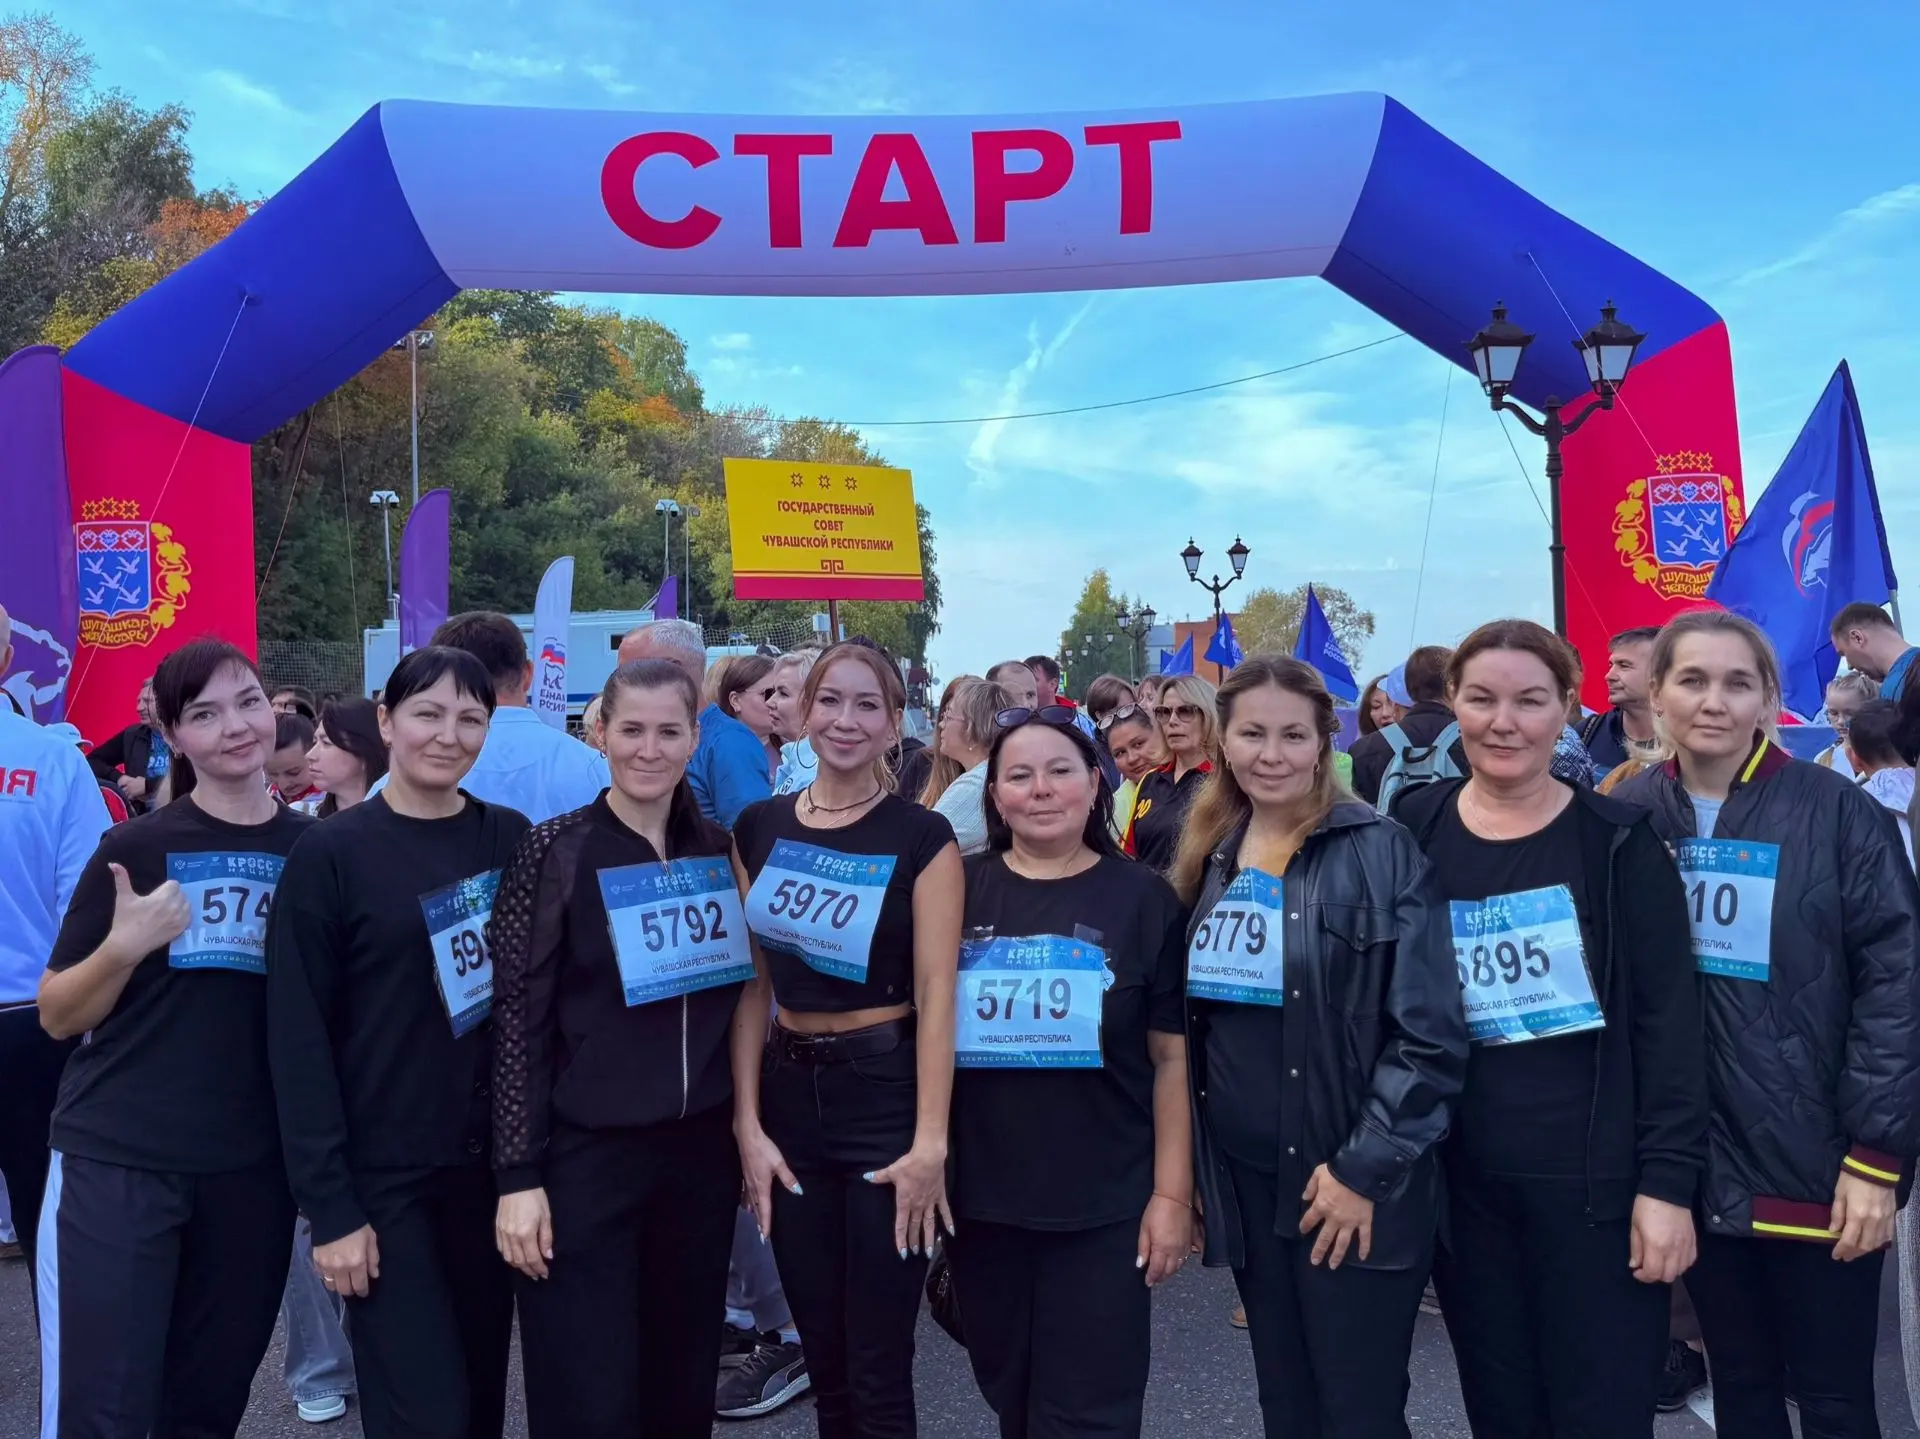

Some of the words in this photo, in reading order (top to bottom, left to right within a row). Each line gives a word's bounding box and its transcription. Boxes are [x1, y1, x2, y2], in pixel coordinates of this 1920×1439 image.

[600, 120, 1182, 250] СТАРТ
[777, 500, 875, 517] ГОСУДАРСТВЕННЫЙ
[813, 519, 844, 532] СОВЕТ
[762, 534, 829, 549] ЧУВАШСКОЙ
[831, 539, 894, 551] РЕСПУБЛИКИ
[226, 856, 274, 872] КРОСС
[815, 854, 857, 872] КРОСС
[228, 867, 274, 878] НАЦИИ
[653, 872, 693, 889] КРОСС
[768, 878, 859, 930] 5970
[1690, 879, 1739, 927] 10
[640, 900, 728, 952] 5792
[1195, 911, 1267, 955] 5779
[203, 935, 251, 947] ЧУВАШСКАЯ
[800, 934, 843, 952] РЕСПУБЛИКА
[1007, 946, 1051, 959] КРОСС
[1220, 965, 1264, 981] РЕСПУБЛИКА
[976, 978, 1071, 1021] 5719
[1503, 990, 1558, 1008] РЕСПУБЛИКА
[978, 1034, 1023, 1045] ЧУВАШСКАЯ
[1024, 1034, 1072, 1044] РЕСПУБЛИКА
